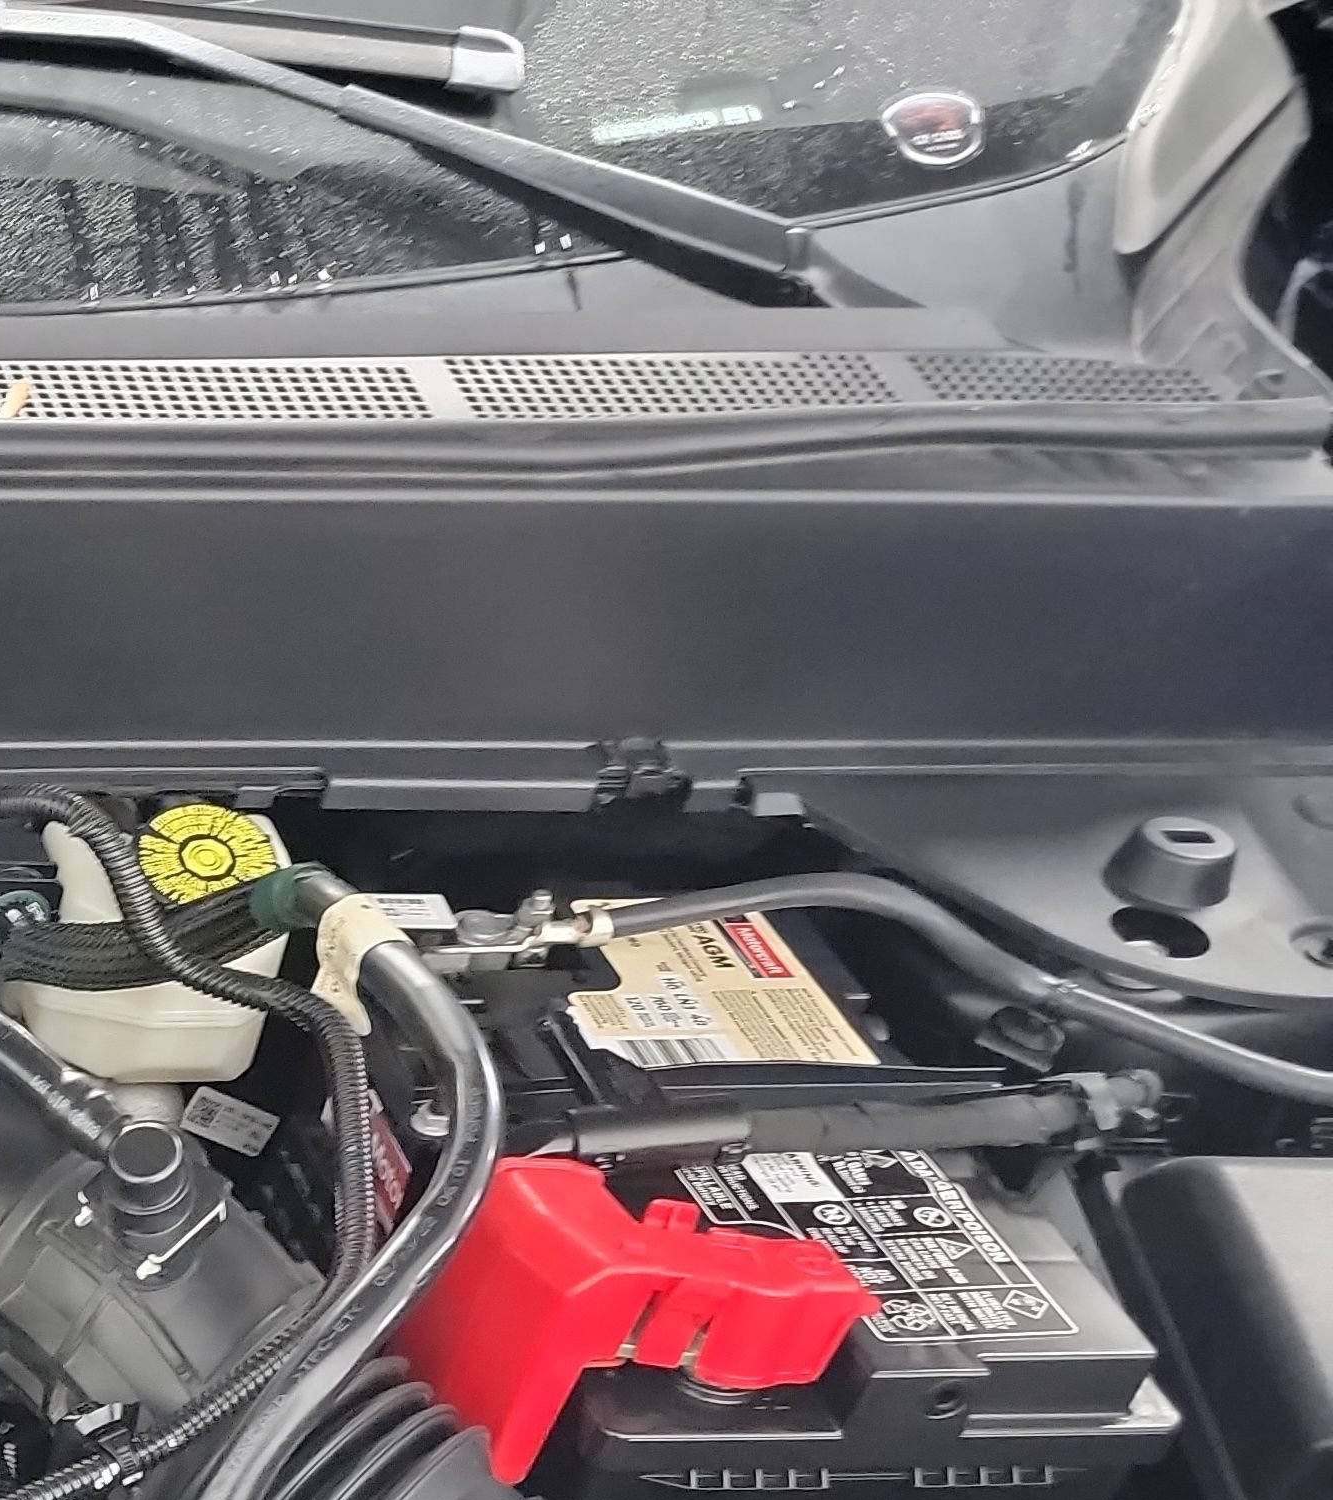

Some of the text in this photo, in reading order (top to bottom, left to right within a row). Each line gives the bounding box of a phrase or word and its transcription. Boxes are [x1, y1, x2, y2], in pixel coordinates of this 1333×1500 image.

[694, 934, 735, 969] AGM
[736, 926, 783, 976] Motorcraft
[624, 996, 645, 1011] 120
